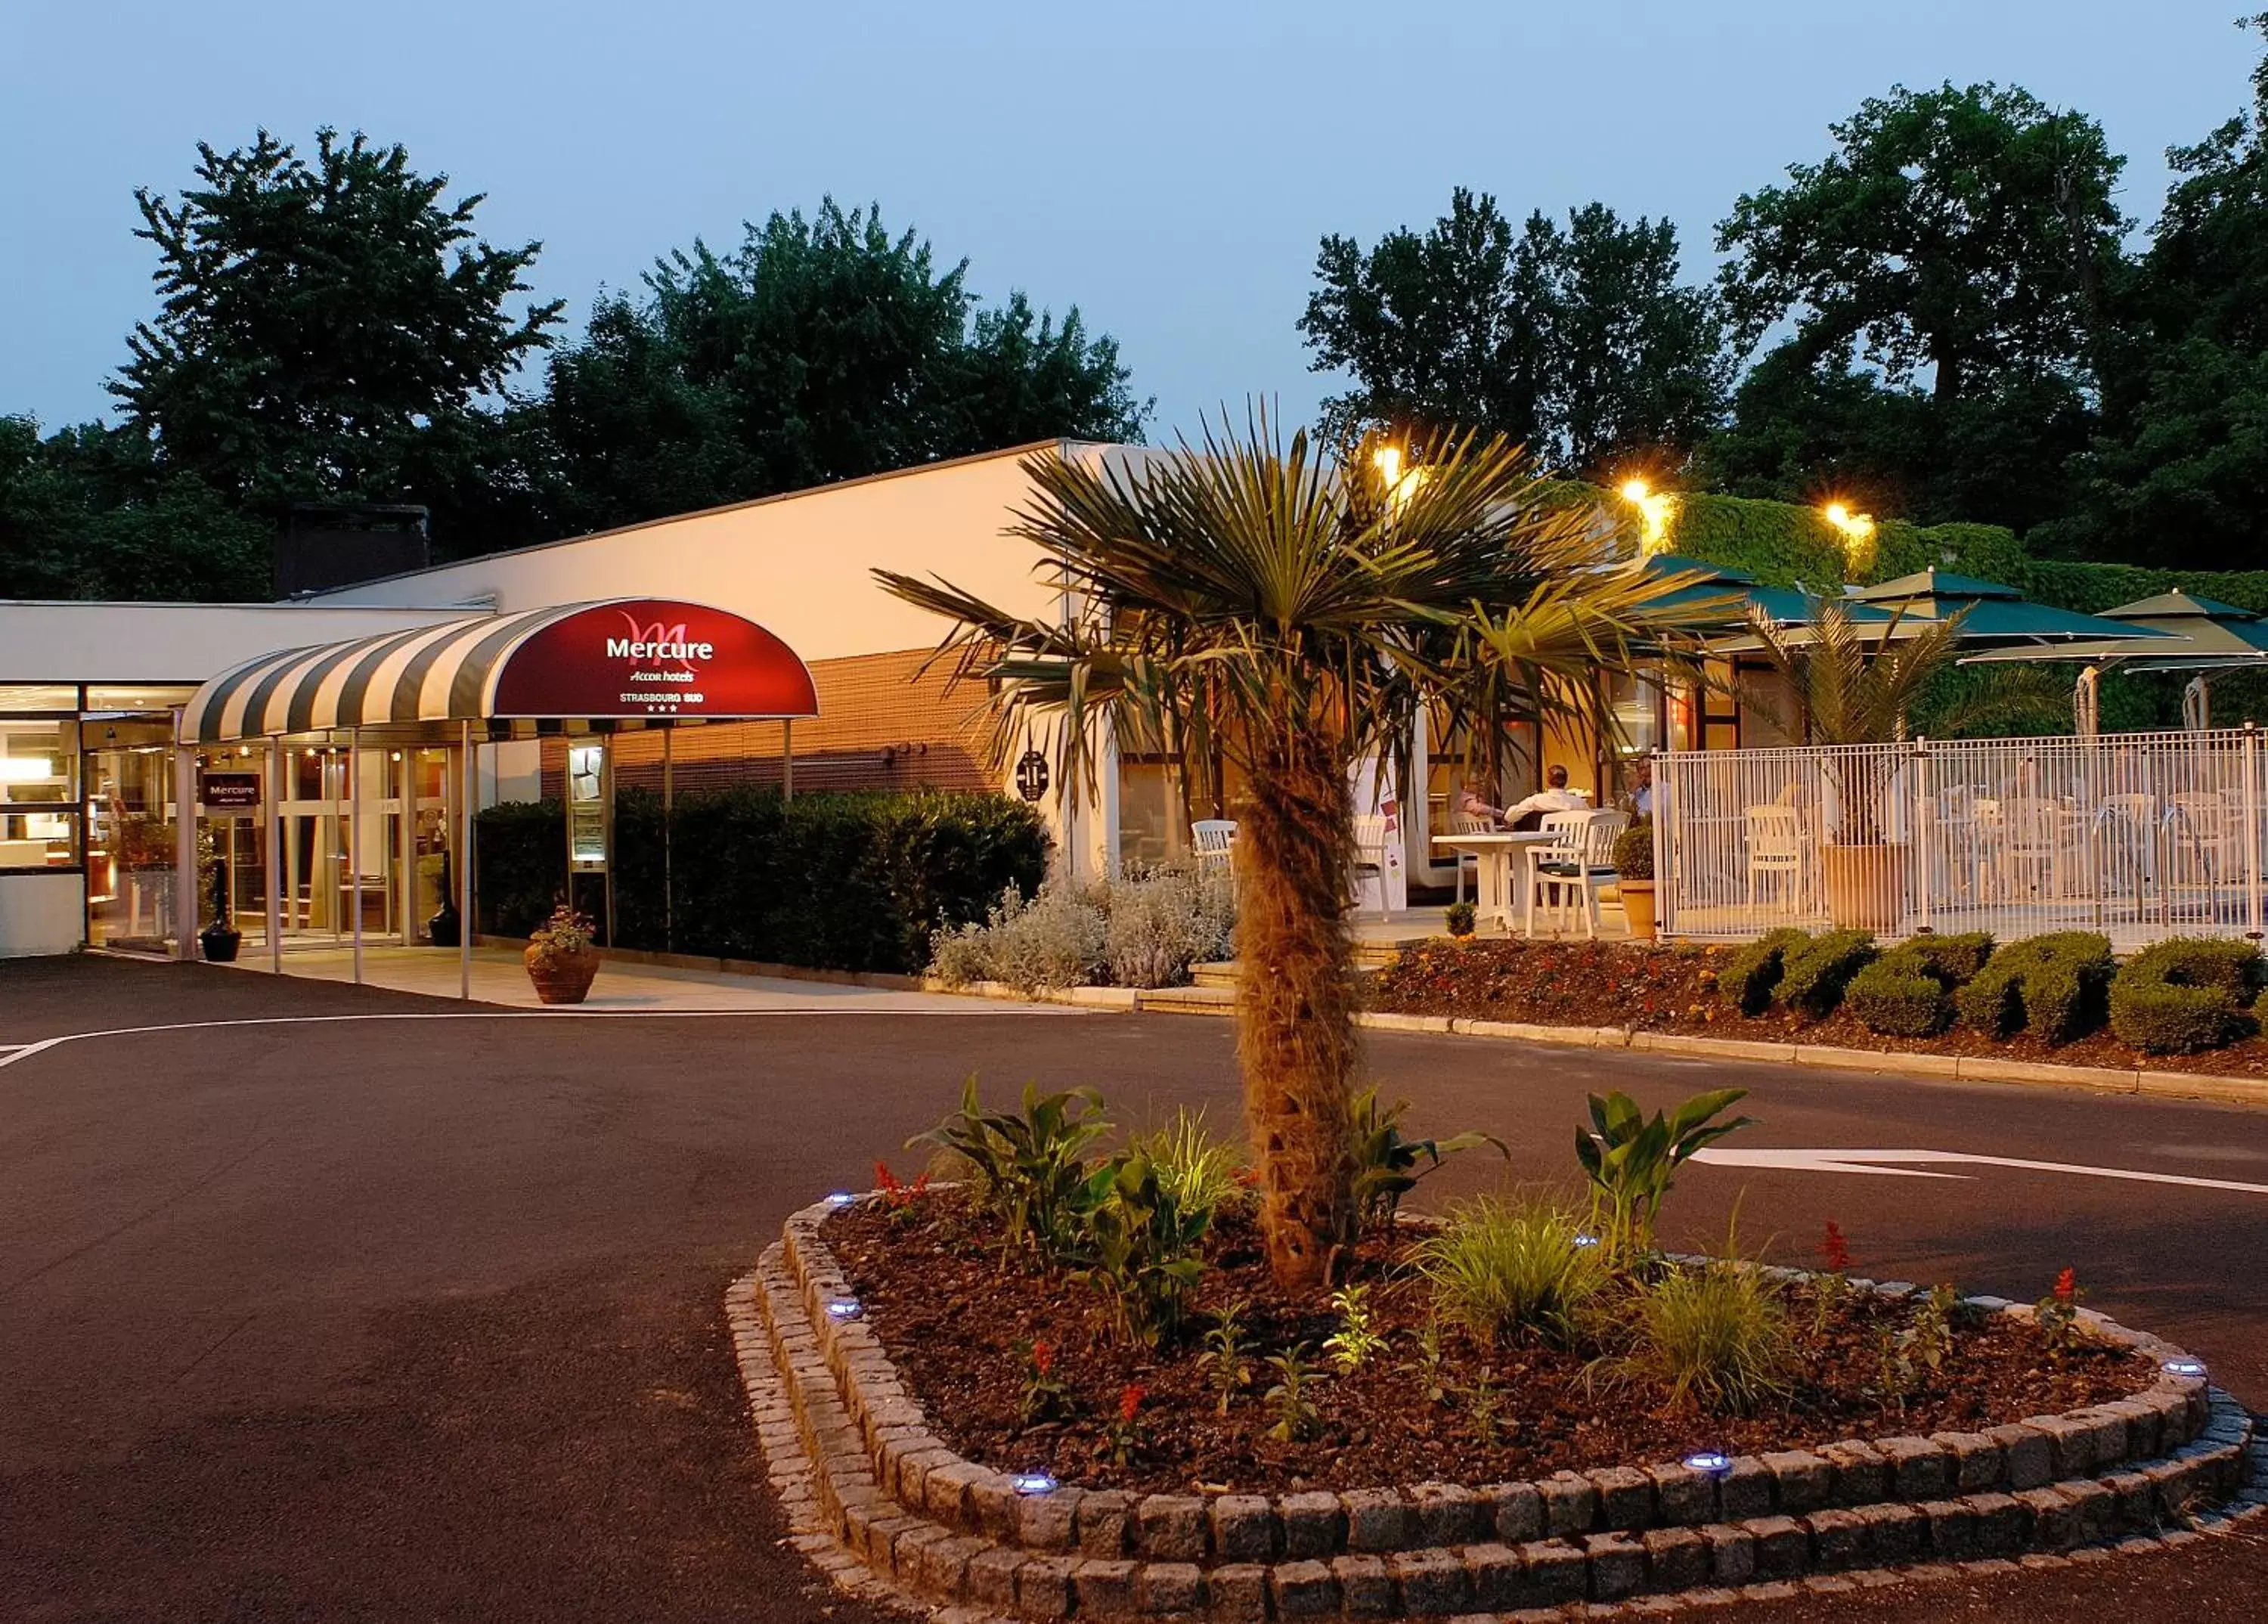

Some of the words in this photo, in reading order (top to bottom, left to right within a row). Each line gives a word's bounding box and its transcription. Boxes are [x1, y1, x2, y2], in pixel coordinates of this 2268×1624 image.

[606, 638, 713, 660] Mercure
[620, 693, 681, 702] STRASBOURG
[683, 693, 704, 702] SUD
[209, 786, 255, 795] Mercure
